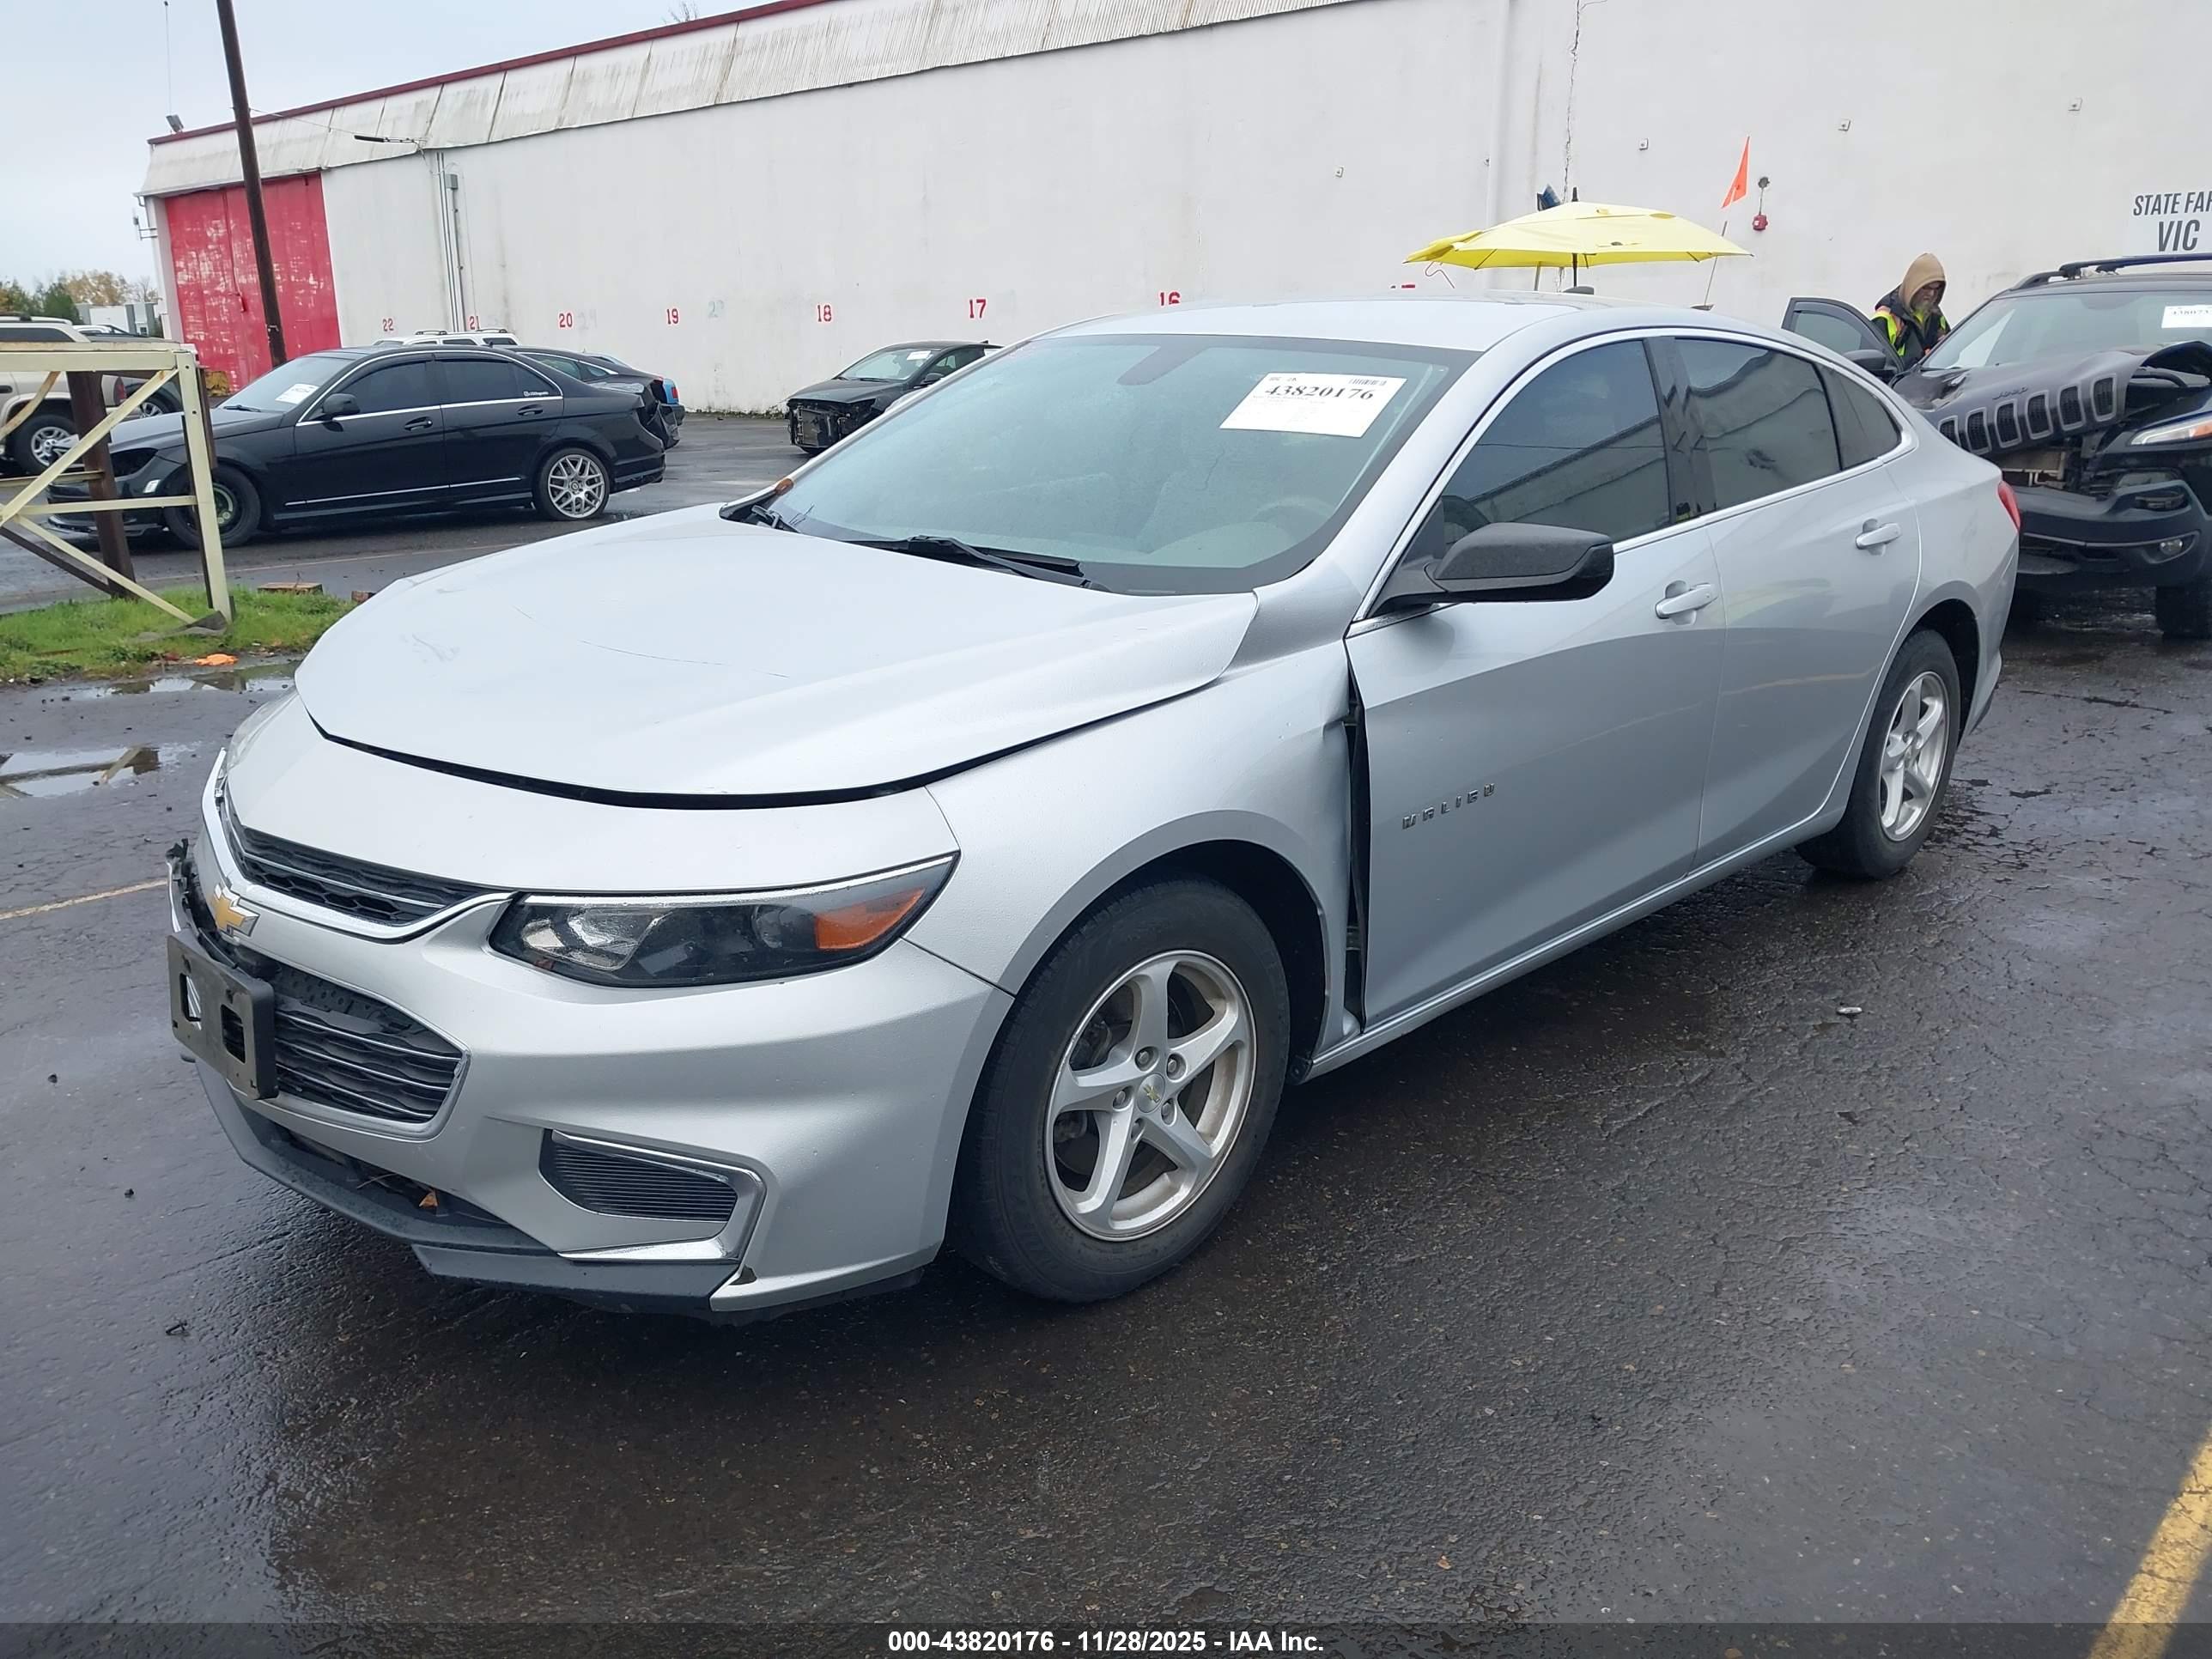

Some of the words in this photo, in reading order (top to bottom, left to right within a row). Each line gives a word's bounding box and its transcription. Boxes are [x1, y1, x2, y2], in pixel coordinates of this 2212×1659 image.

[2133, 193, 2182, 216] STATE
[2158, 219, 2200, 252] VIC
[665, 308, 679, 325] 19
[817, 304, 833, 323] 18
[969, 298, 987, 319] 17
[382, 319, 394, 331] 22
[469, 315, 480, 330] 21
[558, 313, 574, 328] 20
[1265, 385, 1374, 400] 43820176
